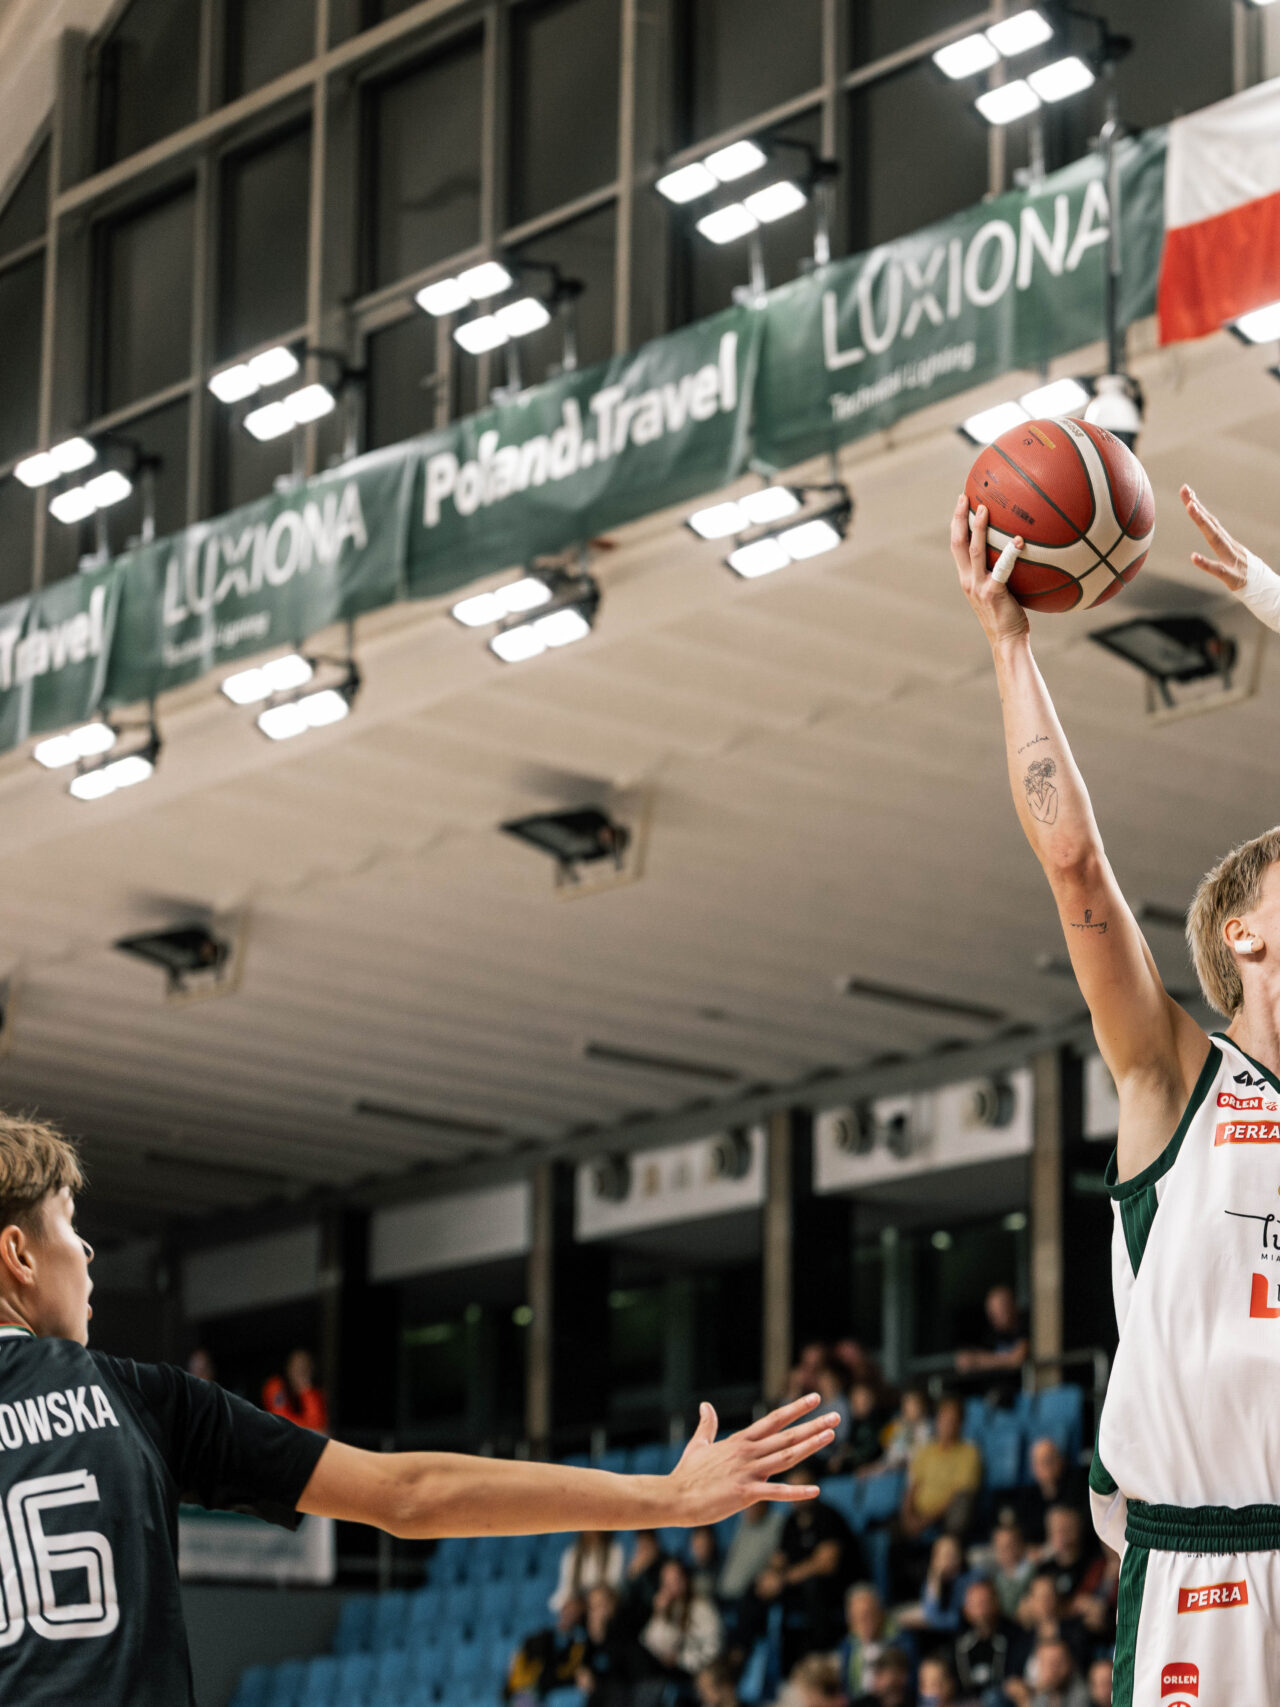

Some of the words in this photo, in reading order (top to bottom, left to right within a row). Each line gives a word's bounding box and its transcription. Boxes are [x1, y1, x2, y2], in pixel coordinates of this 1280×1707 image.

[822, 179, 1110, 372] LUXIONA
[422, 330, 738, 528] Poland.Travel
[163, 480, 367, 627] LUXIONA
[1220, 1095, 1259, 1109] ORLEN
[1224, 1124, 1280, 1140] PERŁA
[0, 1385, 120, 1450] OWSKA
[1187, 1585, 1242, 1608] PERŁA
[1163, 1675, 1197, 1684] ORLEN
